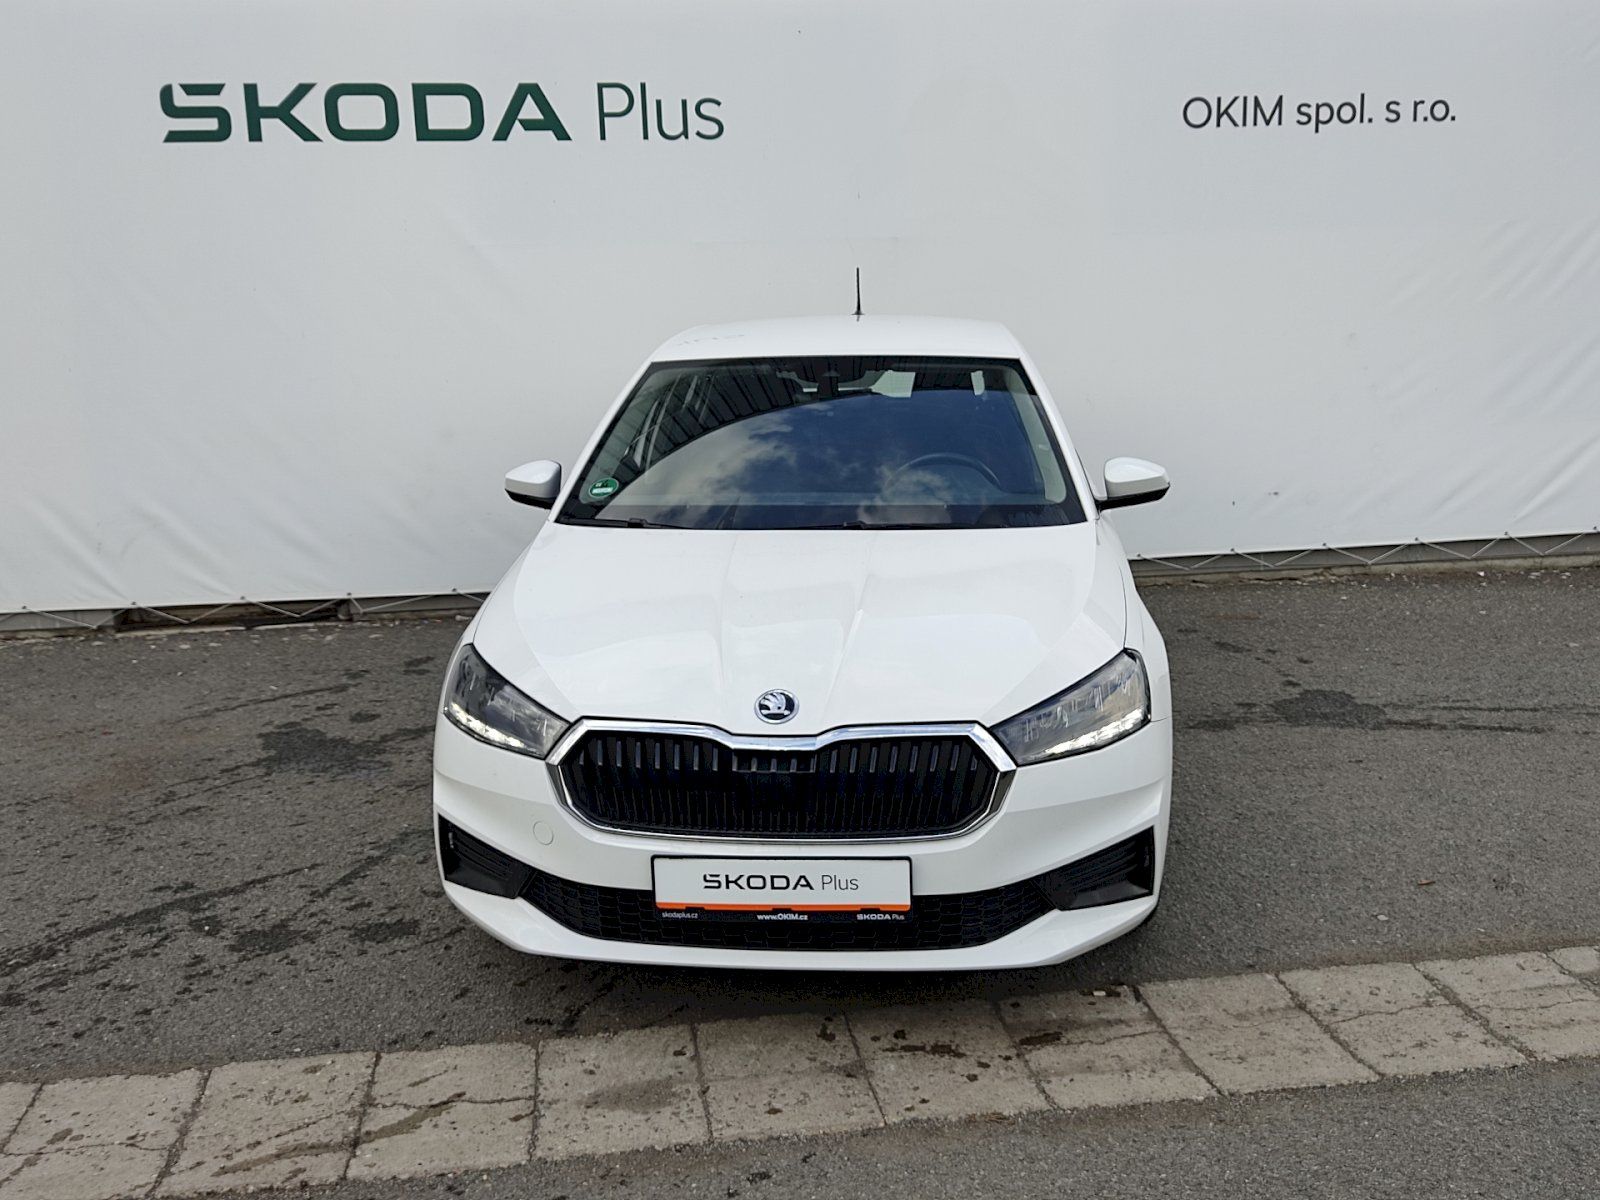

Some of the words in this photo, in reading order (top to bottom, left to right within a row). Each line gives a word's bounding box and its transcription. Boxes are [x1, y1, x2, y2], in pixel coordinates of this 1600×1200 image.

[596, 81, 725, 140] Plus
[1182, 95, 1284, 129] OKIM
[1295, 93, 1373, 134] spol.
[1384, 99, 1402, 123] s
[1412, 99, 1456, 122] r.o.
[821, 874, 859, 891] Plus
